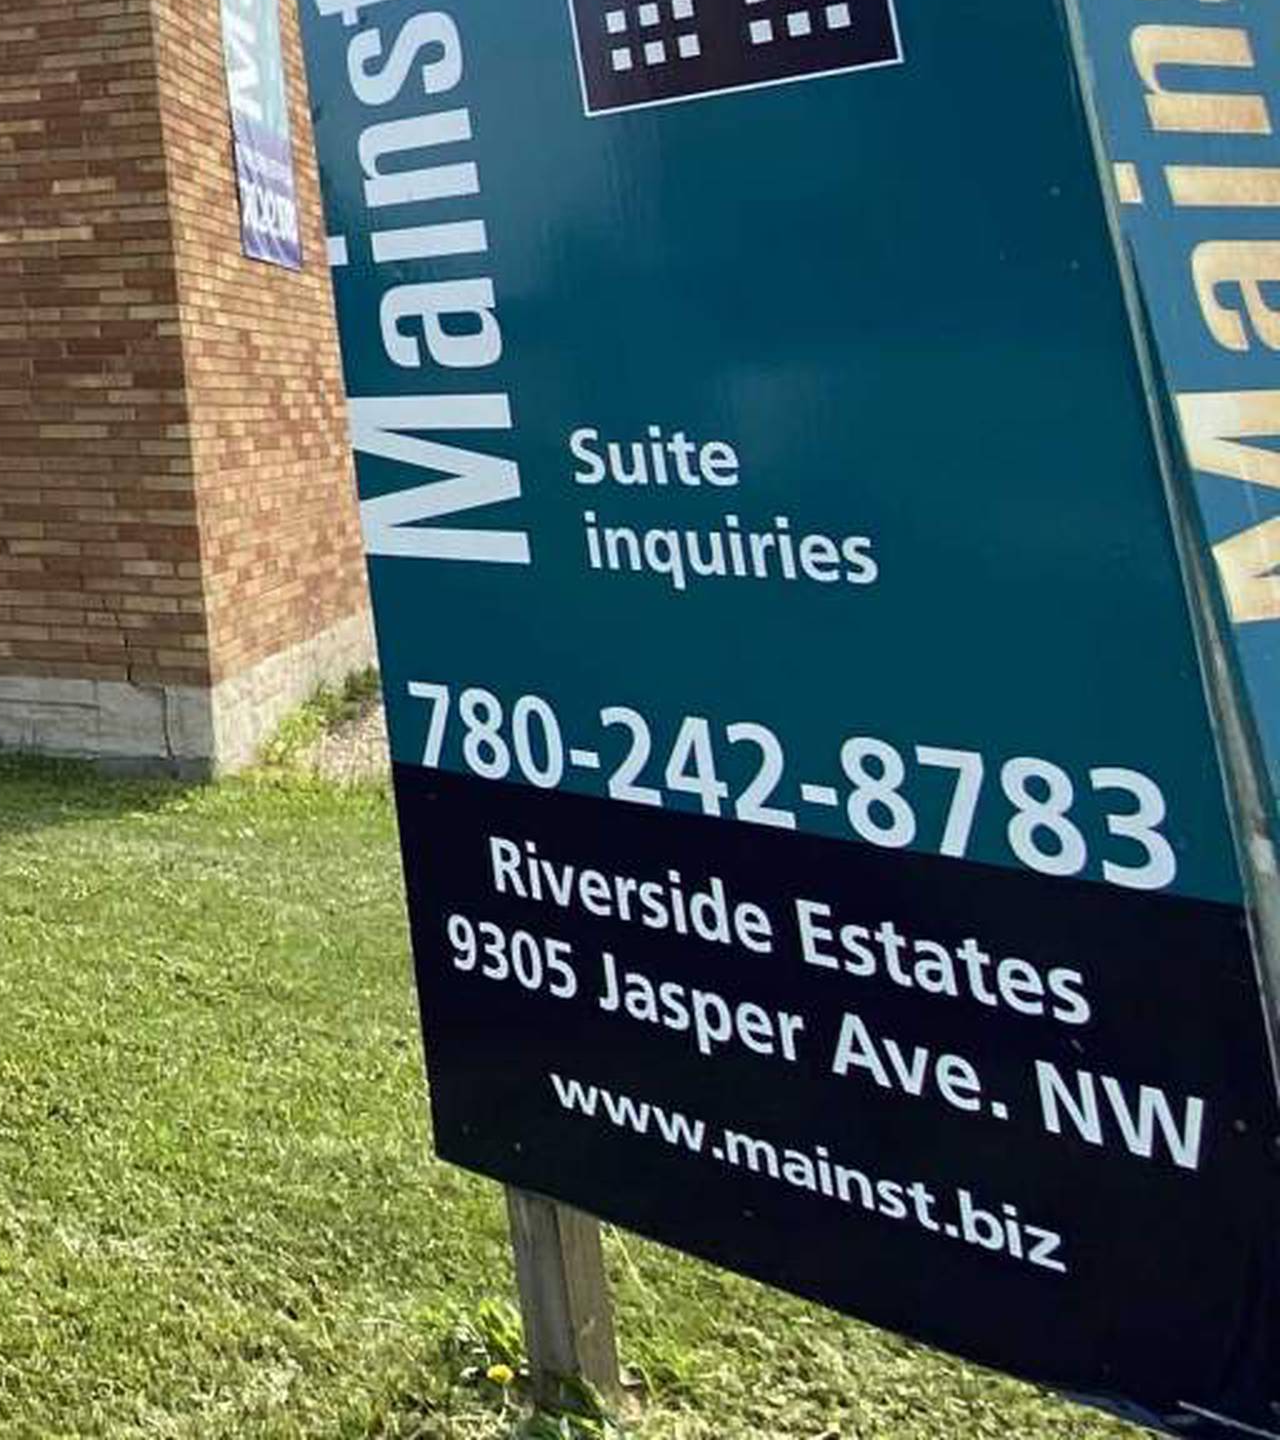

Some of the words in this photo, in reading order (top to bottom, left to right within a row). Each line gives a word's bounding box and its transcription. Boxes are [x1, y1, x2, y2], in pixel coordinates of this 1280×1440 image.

[570, 426, 739, 487] Suite
[584, 512, 879, 590] inquiries
[406, 681, 1178, 892] 780-242-8783
[489, 835, 773, 953] Riverside
[795, 897, 1092, 1025] Estates
[447, 914, 578, 999] 9305
[599, 952, 804, 1061] Jasper
[832, 1011, 1009, 1121] Ave.
[1034, 1059, 1205, 1170] NW
[550, 1071, 1067, 1274] www.mainst.biz
